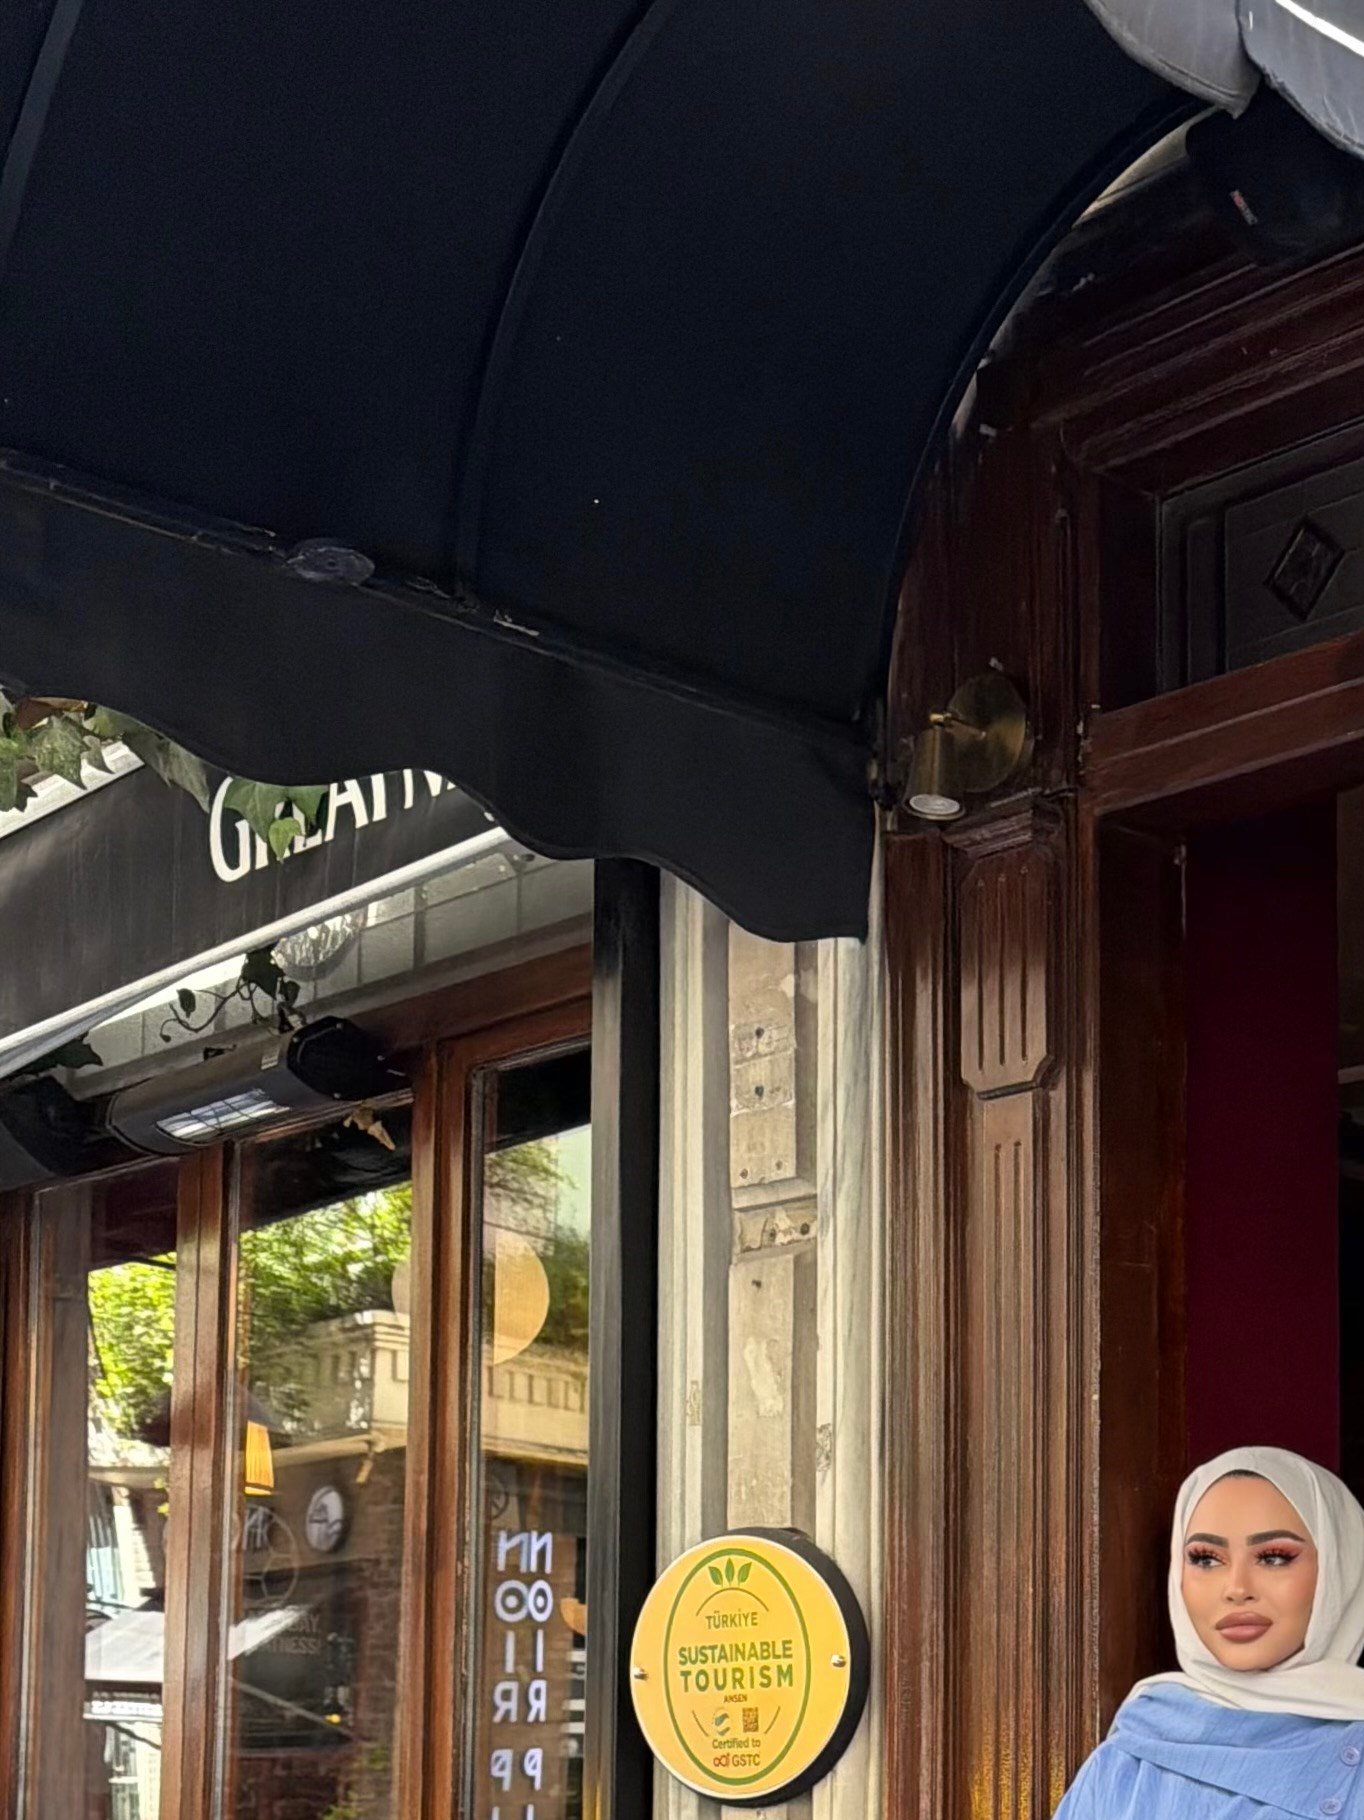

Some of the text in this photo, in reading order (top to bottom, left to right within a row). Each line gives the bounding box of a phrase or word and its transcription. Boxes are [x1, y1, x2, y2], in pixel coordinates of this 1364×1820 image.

[705, 1609, 758, 1629] TÜRKİYE
[678, 1639, 793, 1665] SUSTAINABLE
[680, 1664, 793, 1692] TOURISM
[732, 1753, 760, 1767] GSTC
